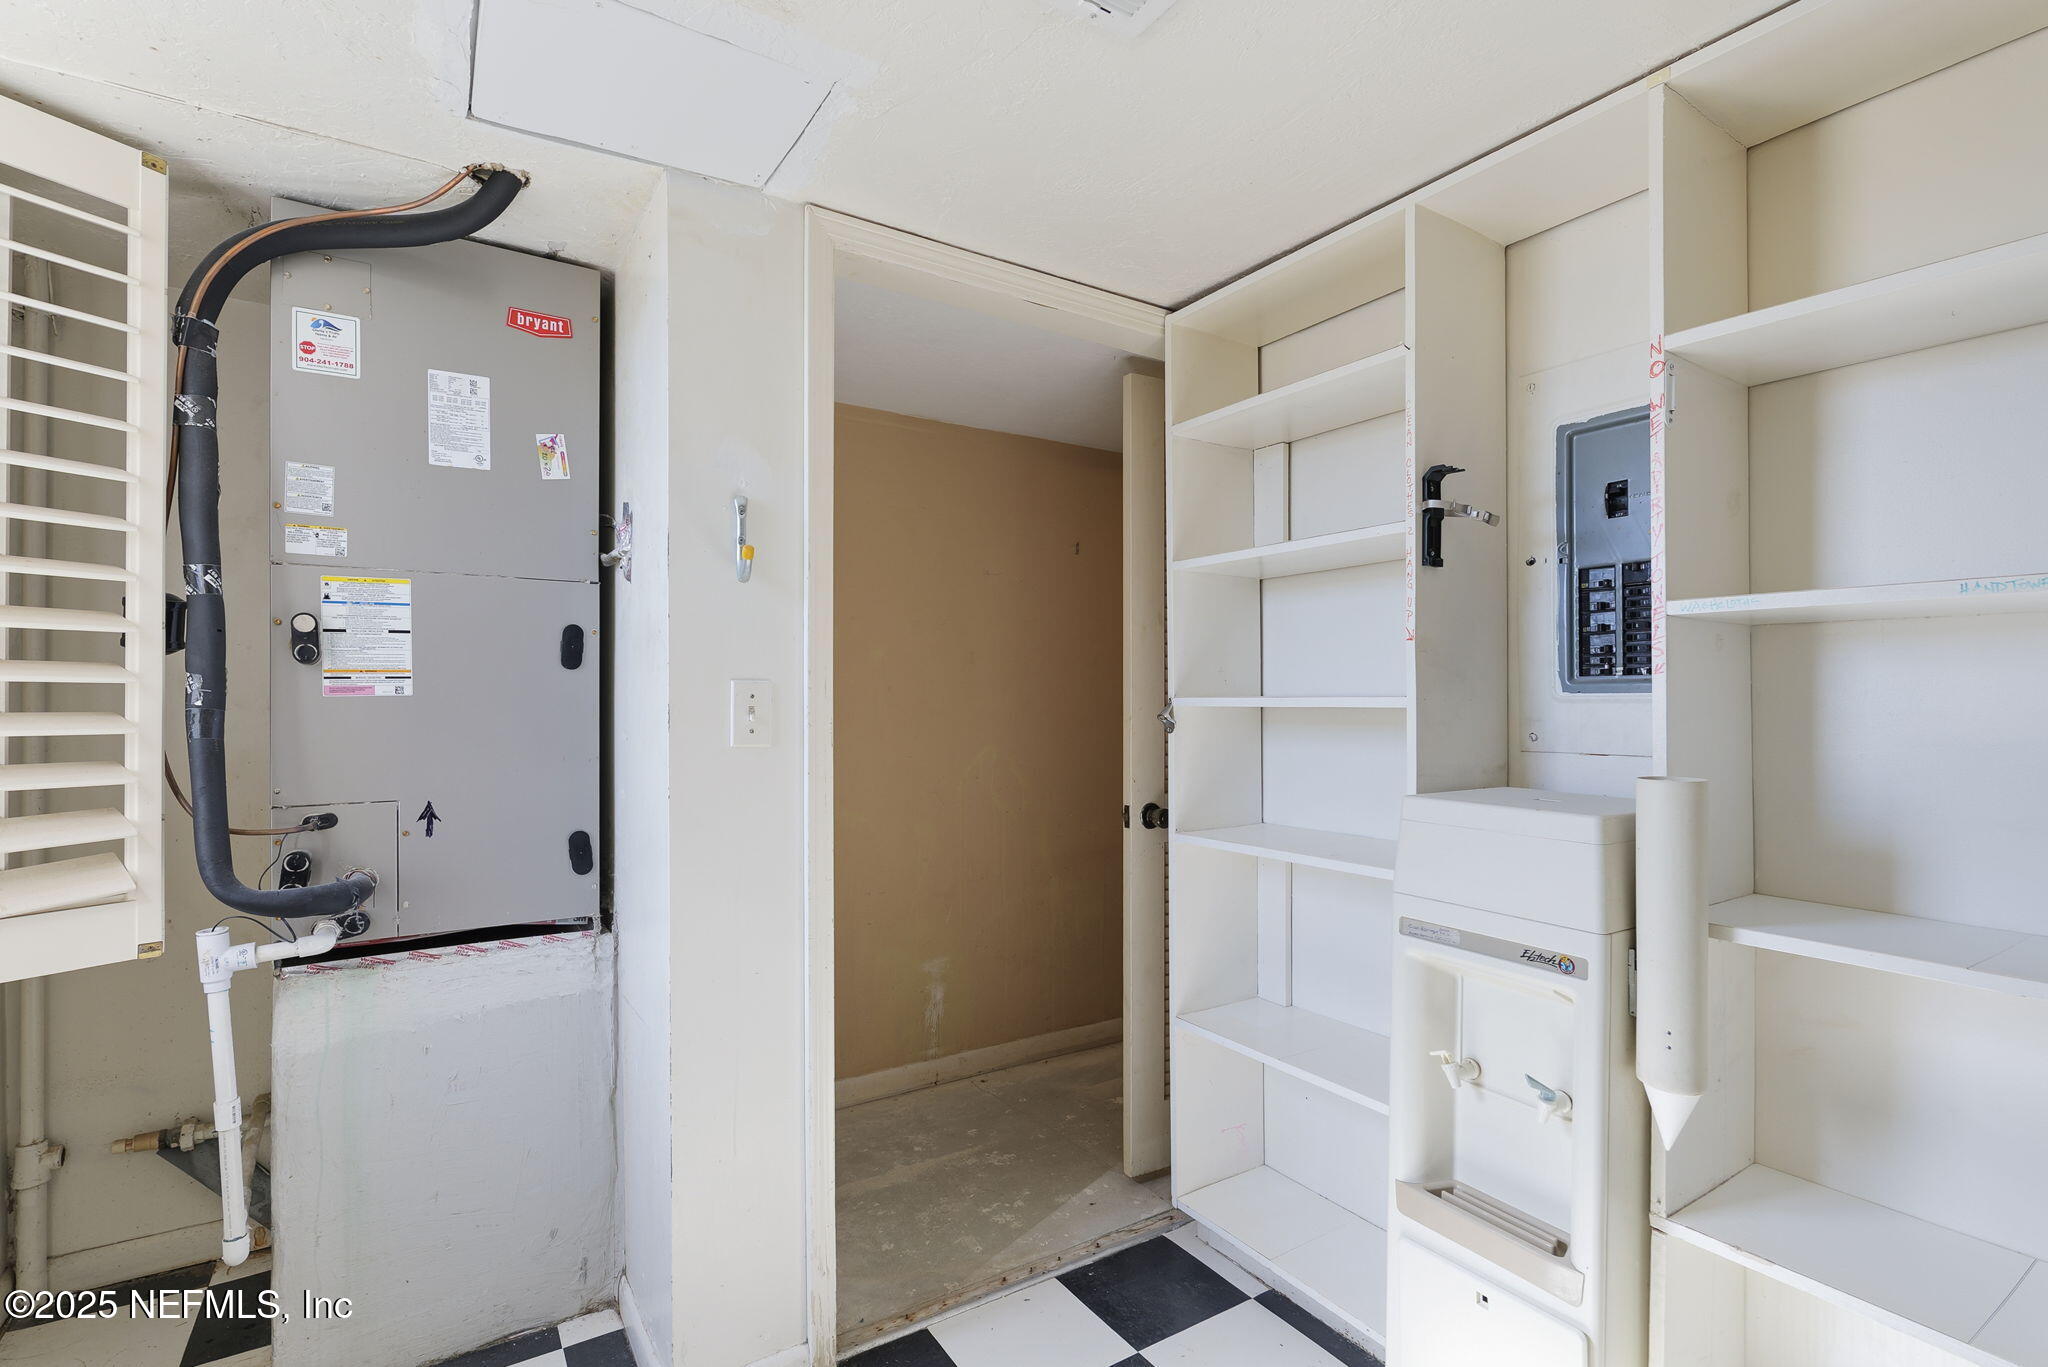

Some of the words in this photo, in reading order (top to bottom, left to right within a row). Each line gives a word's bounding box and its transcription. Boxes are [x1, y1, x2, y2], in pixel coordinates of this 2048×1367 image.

[516, 312, 564, 333] bryant
[299, 343, 316, 352] STOP
[1650, 334, 1666, 378] NO
[299, 355, 354, 369] 904-241-1788
